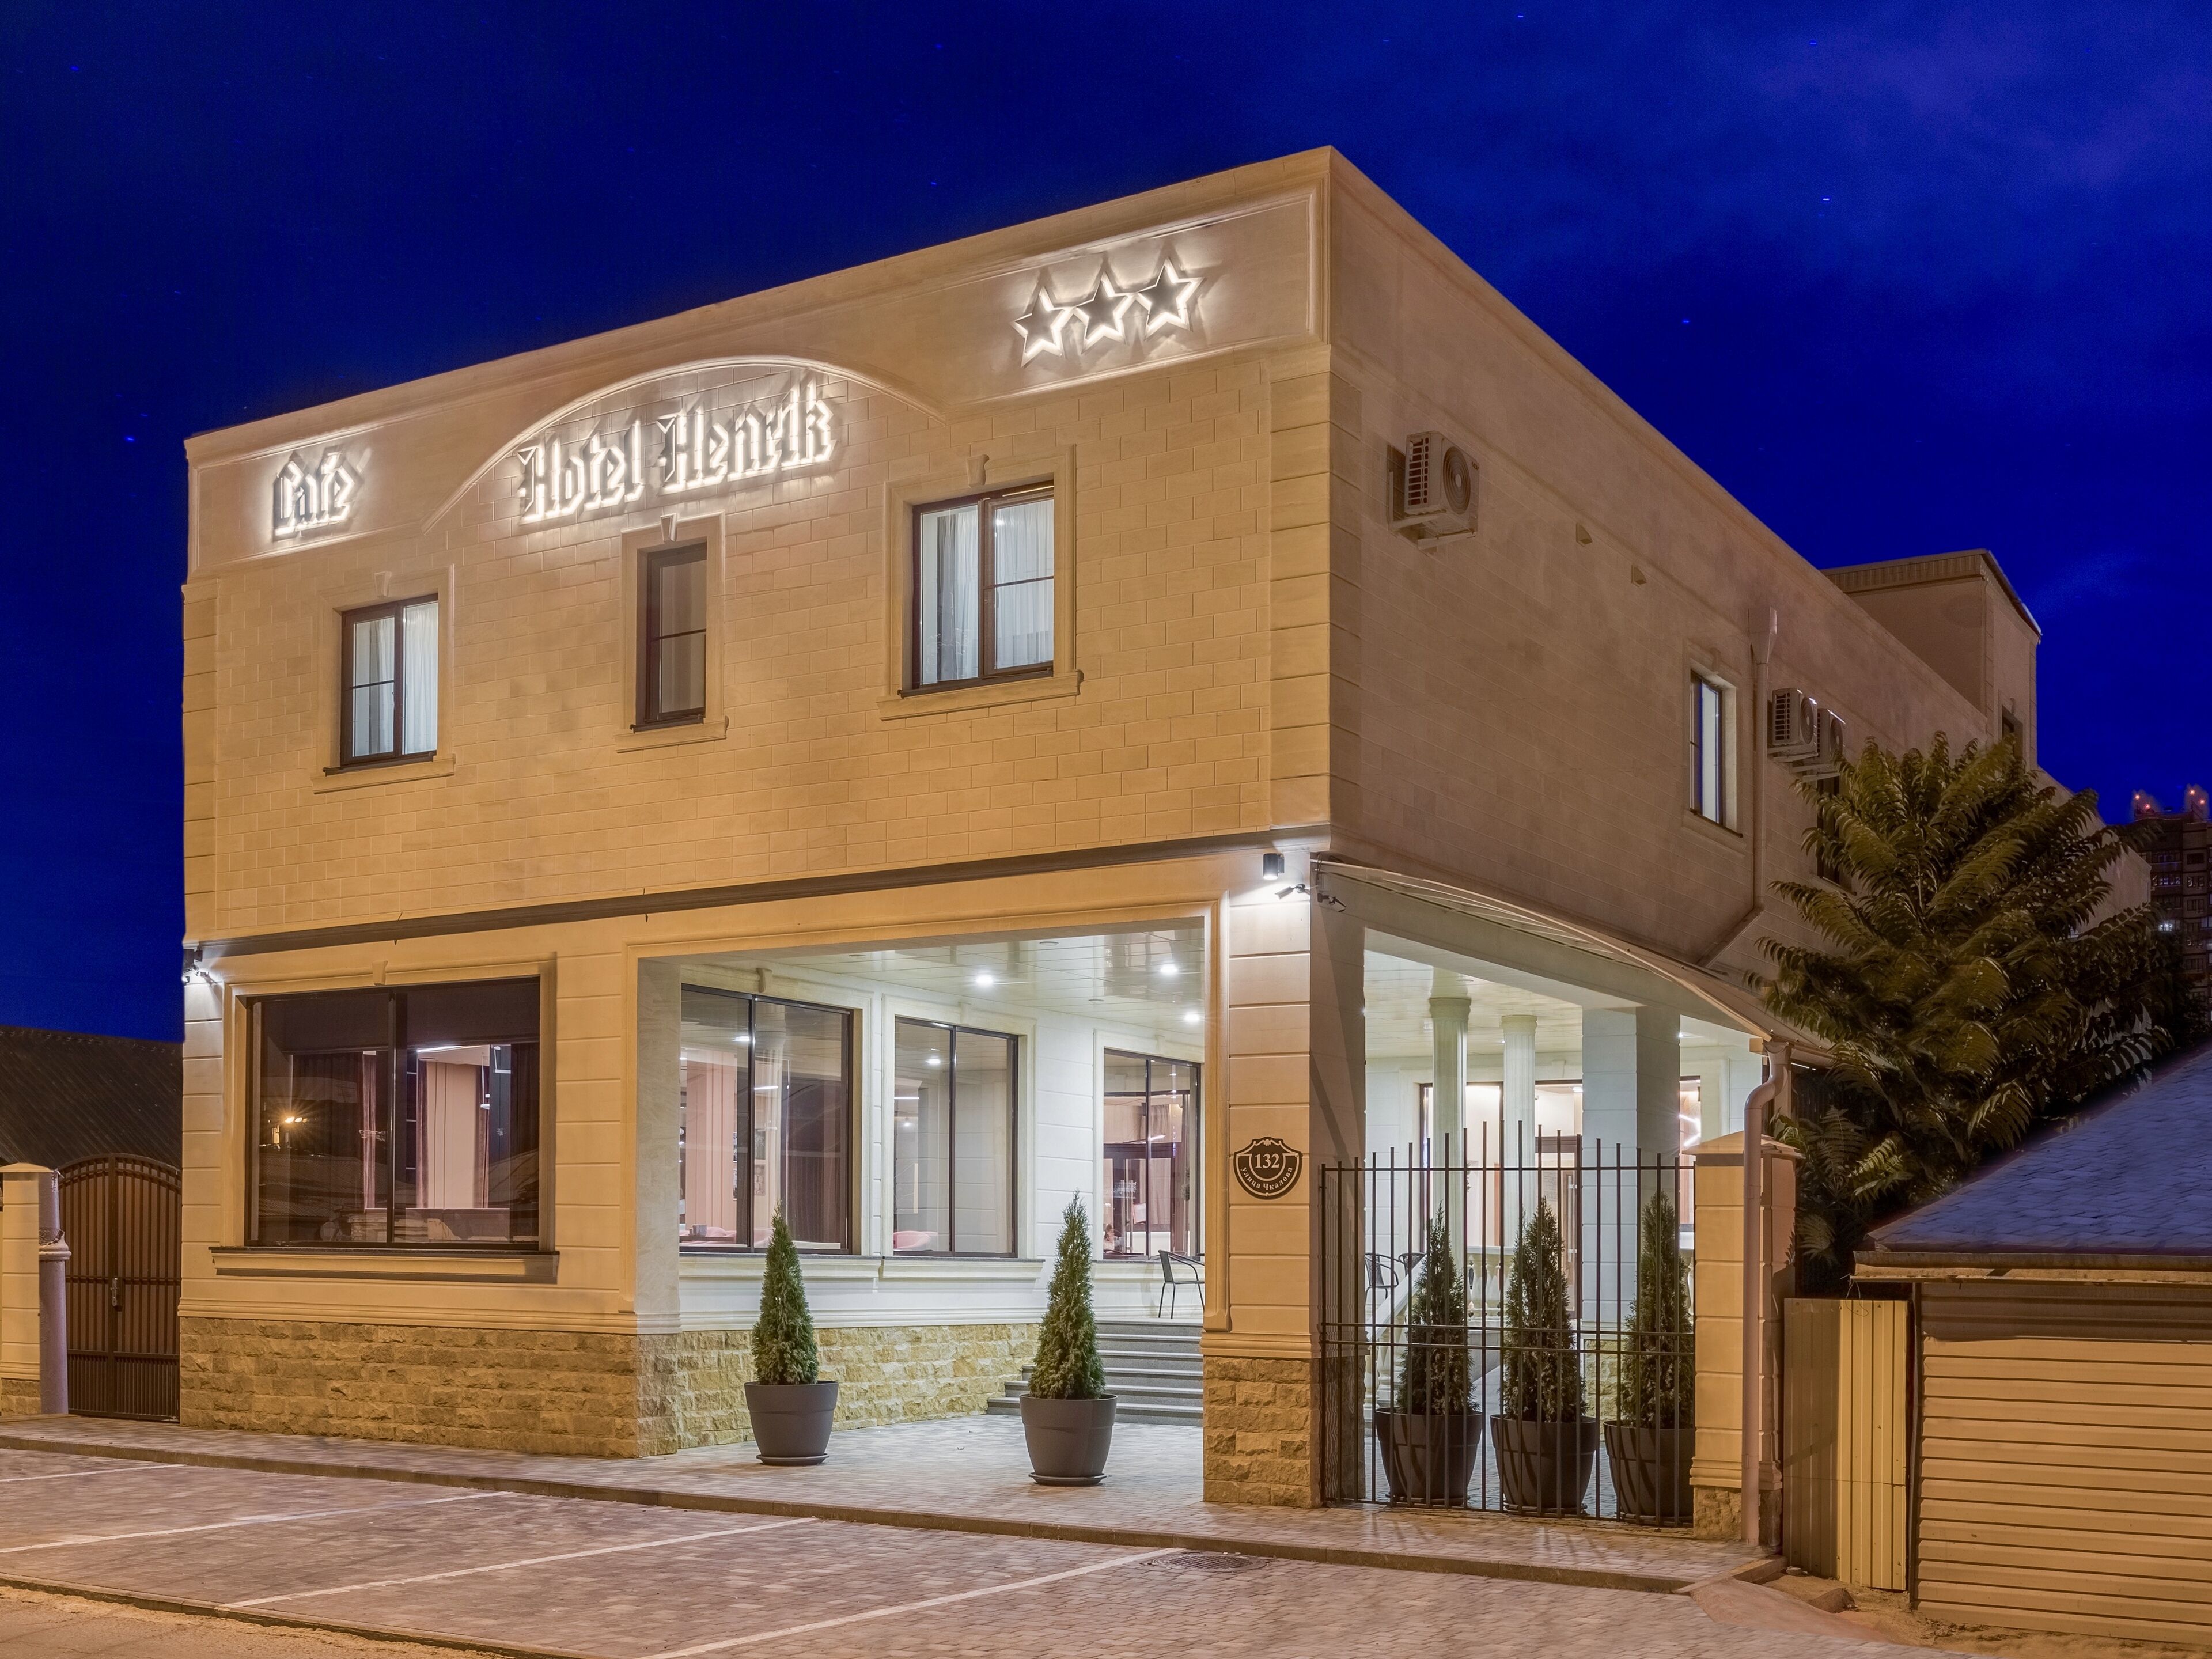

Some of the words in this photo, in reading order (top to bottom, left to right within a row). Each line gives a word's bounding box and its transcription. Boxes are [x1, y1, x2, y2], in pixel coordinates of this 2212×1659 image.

[517, 419, 646, 523] Hotel
[655, 376, 836, 493] Henrik
[1255, 1153, 1280, 1168] 132
[1263, 1167, 1293, 1190] Чкалова
